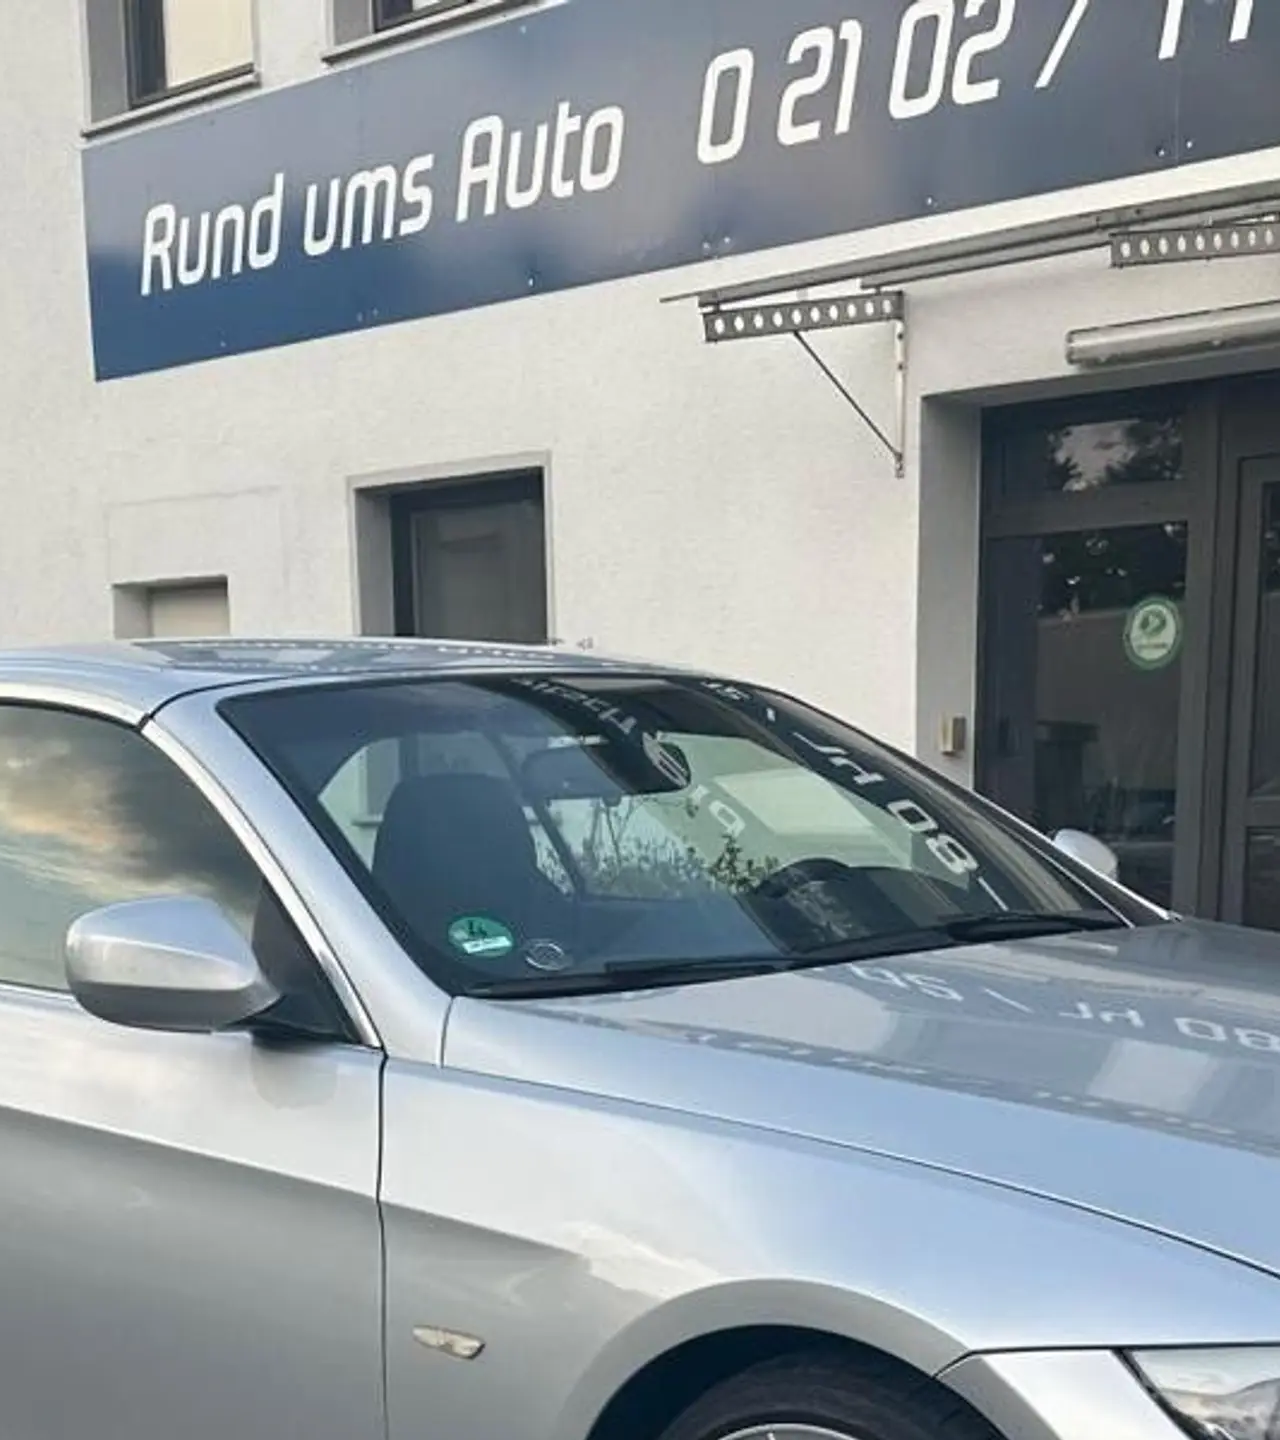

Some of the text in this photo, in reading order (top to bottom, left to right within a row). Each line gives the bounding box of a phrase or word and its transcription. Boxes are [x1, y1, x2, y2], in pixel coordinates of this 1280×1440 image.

[141, 171, 285, 296] Rund
[303, 153, 435, 256] ums
[455, 100, 625, 223] Auto
[776, 19, 863, 146] 21
[888, 0, 1016, 120] 02
